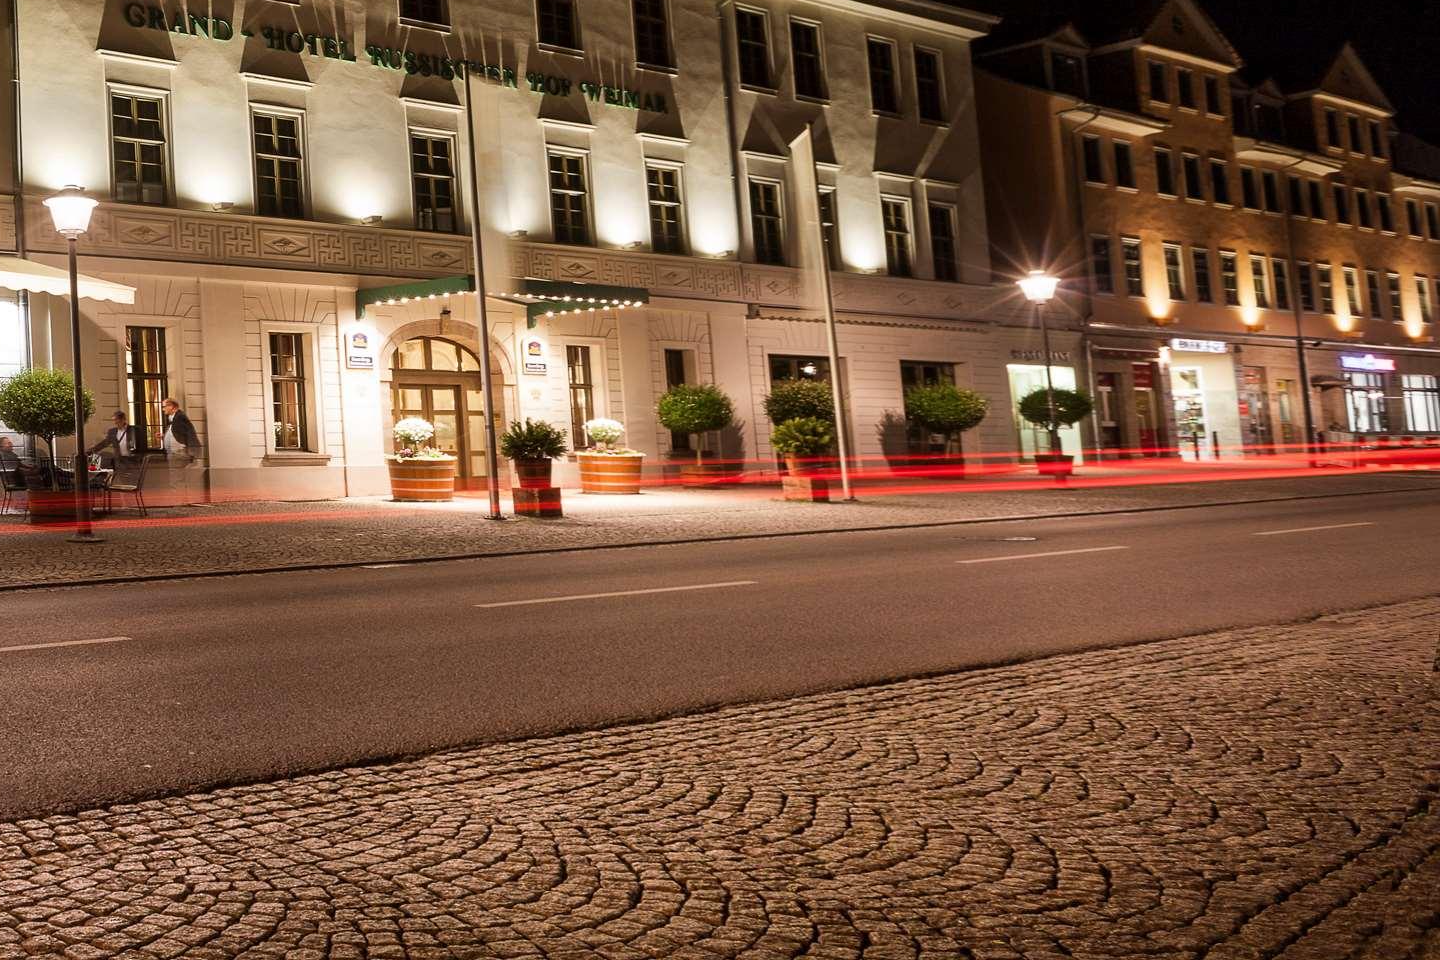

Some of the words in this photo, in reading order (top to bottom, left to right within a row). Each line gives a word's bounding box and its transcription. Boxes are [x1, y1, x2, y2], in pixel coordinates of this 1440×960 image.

[123, 1, 234, 41] GRAND
[263, 25, 357, 63] HOTEL
[525, 71, 572, 97] HOF
[579, 80, 669, 114] WEIMAR
